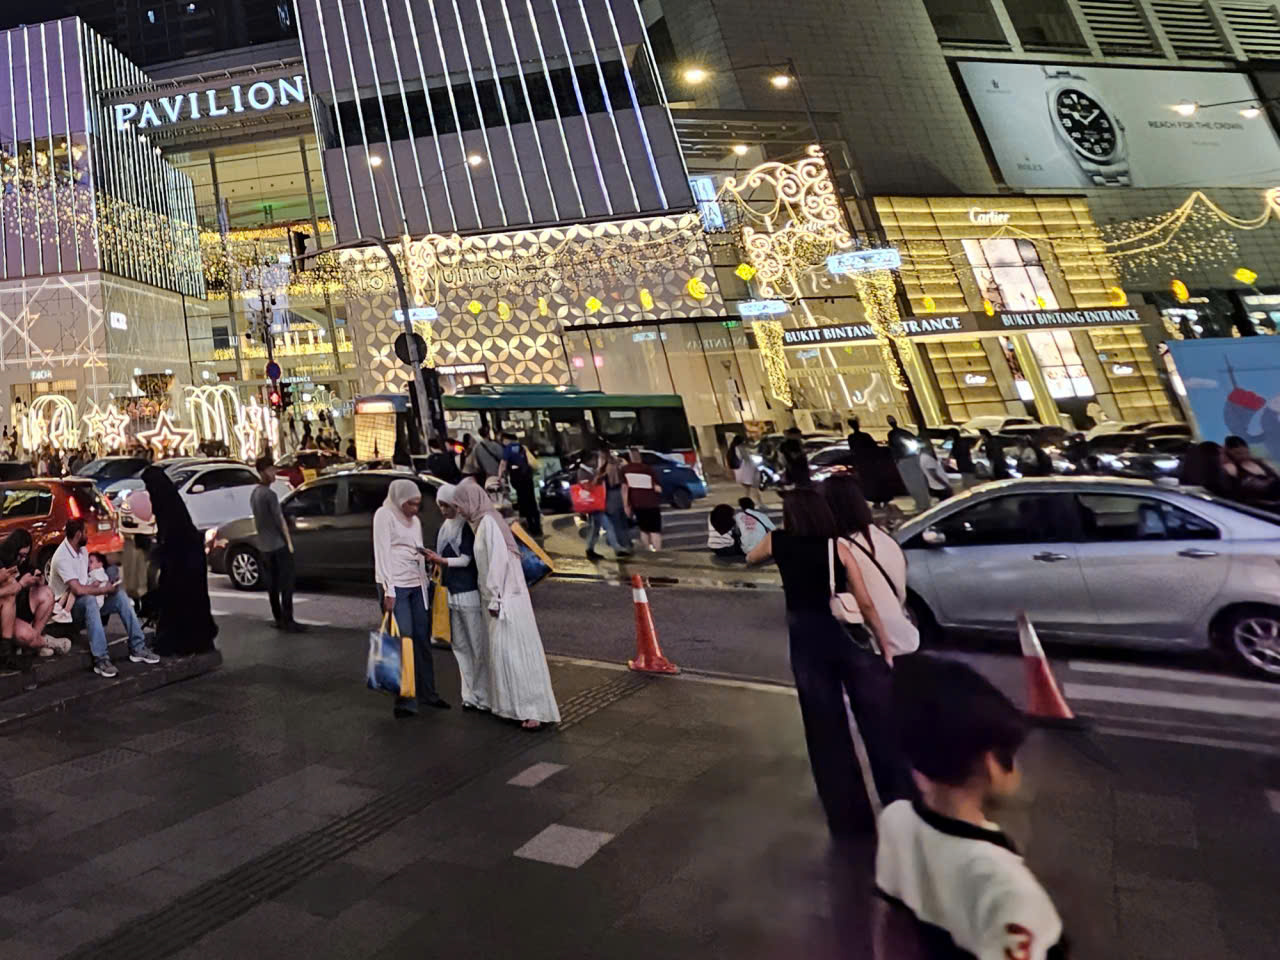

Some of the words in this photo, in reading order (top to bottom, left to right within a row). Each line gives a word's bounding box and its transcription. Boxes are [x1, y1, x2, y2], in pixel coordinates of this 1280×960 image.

[114, 75, 305, 131] PAVILION
[970, 207, 1010, 224] Cartier
[1001, 313, 1034, 326] BUKIT
[1035, 311, 1084, 325] BINTANG
[1084, 309, 1140, 322] ENTRANCE
[785, 328, 821, 344] BUKIT
